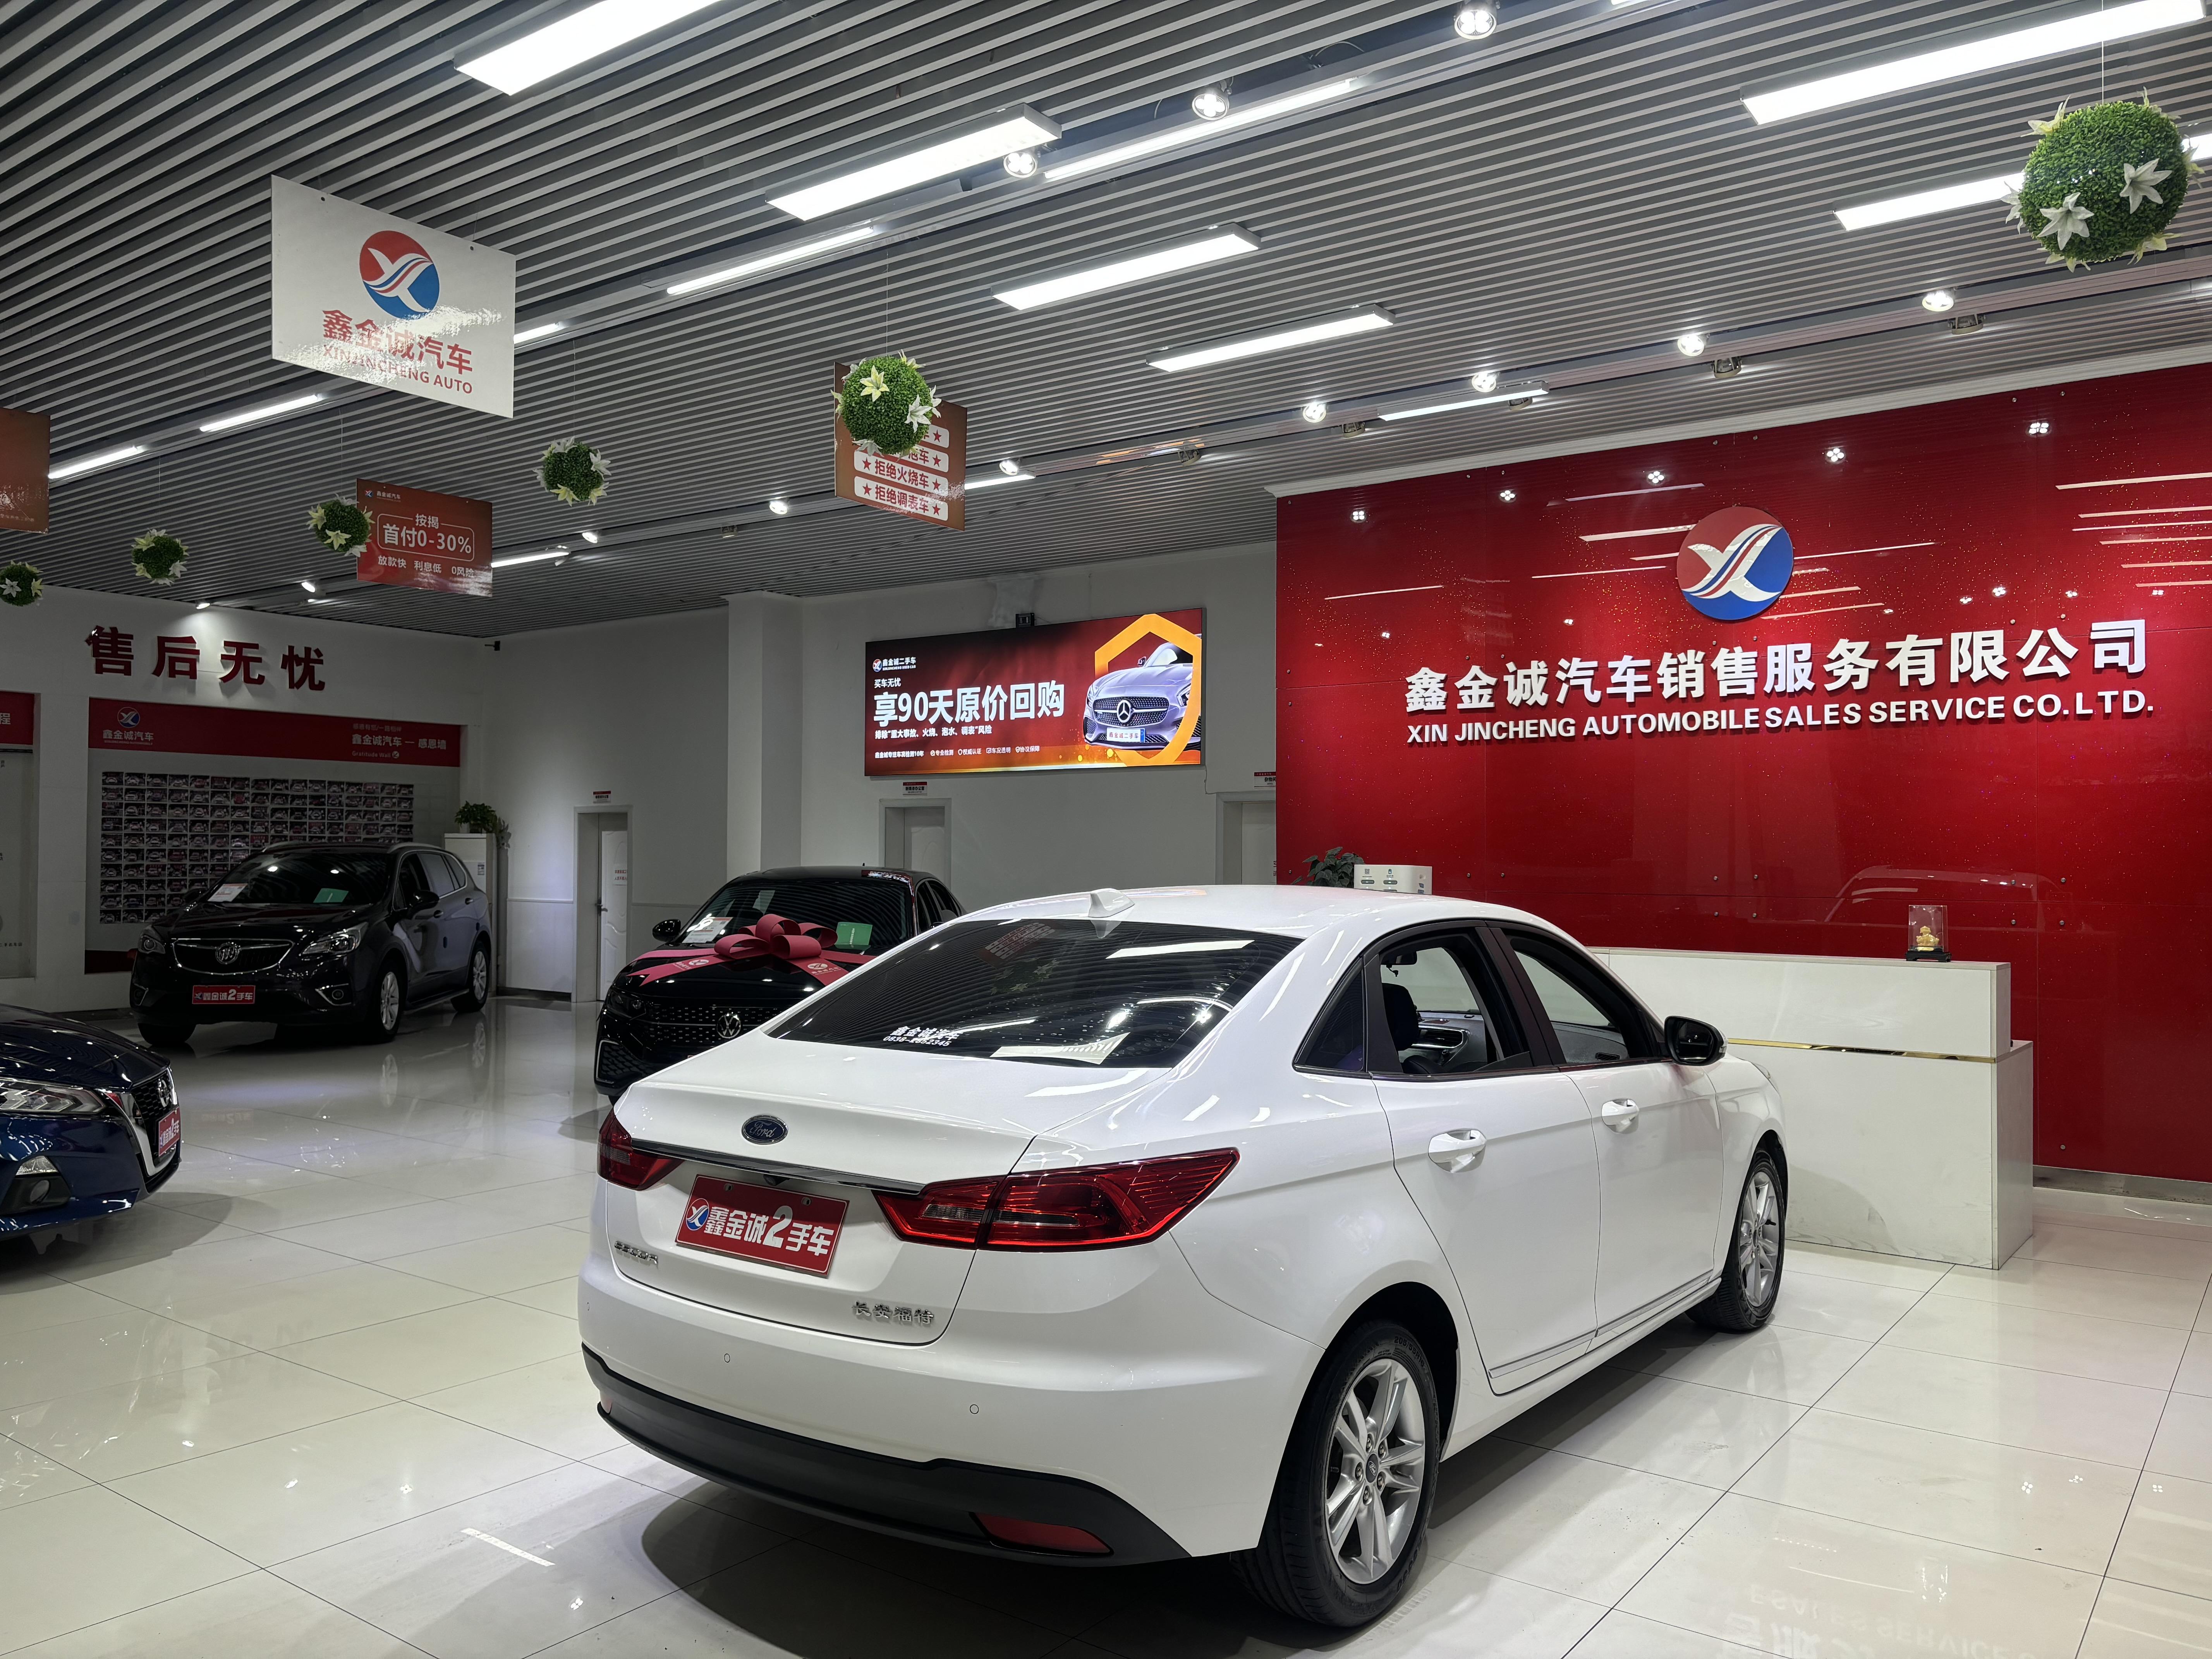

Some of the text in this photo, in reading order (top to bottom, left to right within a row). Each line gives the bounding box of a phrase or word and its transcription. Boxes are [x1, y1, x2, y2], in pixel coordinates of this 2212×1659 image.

[323, 310, 473, 374] 鑫金诚汽车
[433, 374, 473, 394] AUTO
[875, 459, 929, 488] 拒绝火烧车
[875, 484, 929, 513] 拒绝调表车
[416, 514, 439, 529] 按揭
[383, 524, 471, 554] 首付0-30%
[378, 555, 406, 568] 放款快
[414, 560, 441, 573] 利息低
[84, 625, 326, 691] 售后无忧
[1405, 619, 2146, 712] 鑫金诚汽车销售服务有限公司
[874, 677, 901, 688] 买车无忧
[874, 680, 1065, 727] 享90天原价回购
[1407, 723, 1447, 743] XIN
[1455, 717, 1576, 741] JINCHENG
[1583, 707, 1759, 735] AUTOMOBILE
[1765, 702, 1861, 728] SALES
[1869, 696, 2005, 723] SERVICE
[103, 730, 154, 741] 鑫金诚汽车
[352, 734, 402, 747] 鑫金诚汽车
[890, 1026, 964, 1041] 鑫金诚汽车
[749, 1121, 777, 1138] Ford
[704, 1205, 835, 1256] 鑫金诚2手车
[851, 1300, 934, 1324] 长安福特
